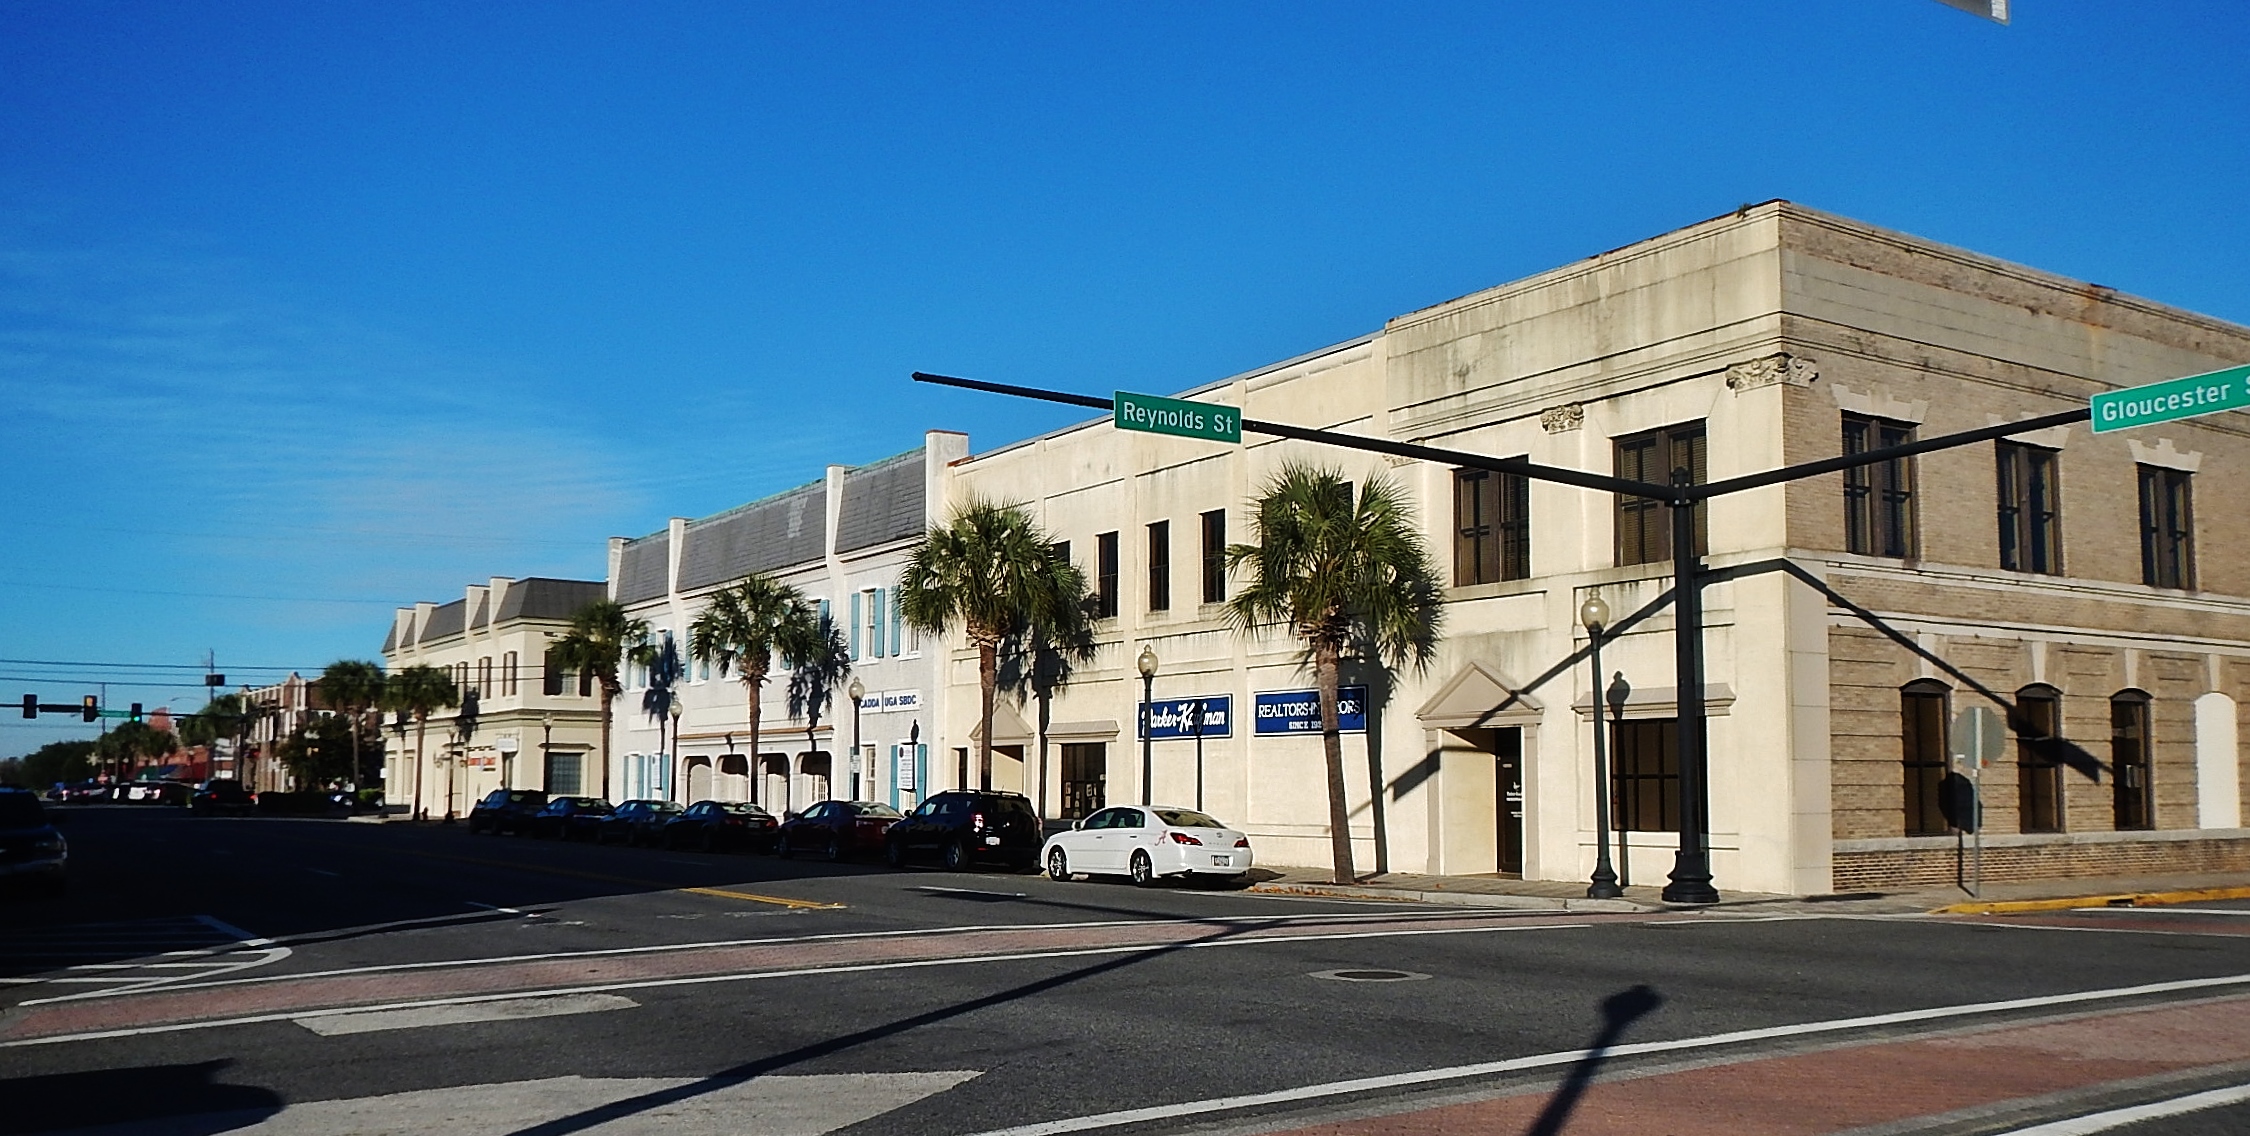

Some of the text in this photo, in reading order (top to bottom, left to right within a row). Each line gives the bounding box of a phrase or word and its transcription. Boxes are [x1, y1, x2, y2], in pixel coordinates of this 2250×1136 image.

[2102, 383, 2231, 422] Gloucester
[1123, 401, 1233, 434] Reynolds St
[884, 694, 917, 707] UGA SBDC
[1288, 720, 1323, 730] SINCE 192
